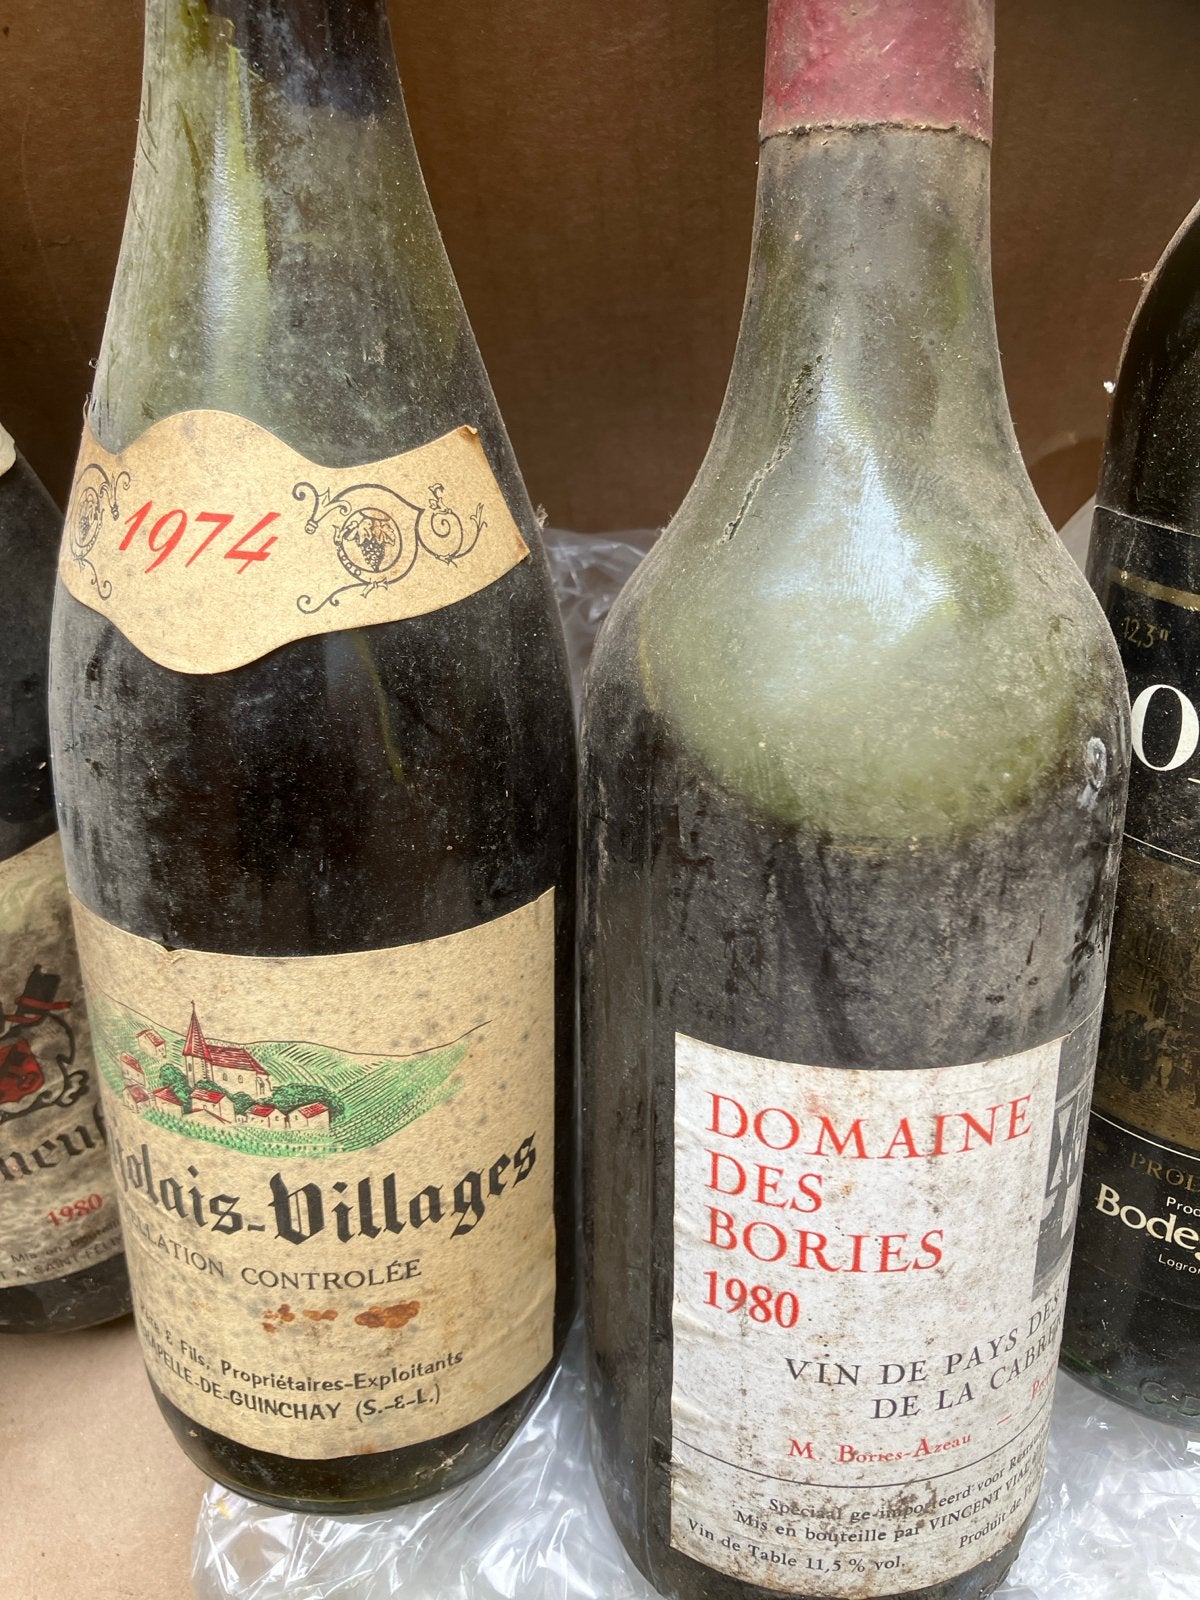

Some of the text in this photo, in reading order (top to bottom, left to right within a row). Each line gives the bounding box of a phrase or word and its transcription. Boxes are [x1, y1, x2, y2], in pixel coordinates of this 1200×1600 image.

[118, 500, 281, 574] 1974
[1131, 684, 1200, 771] O
[704, 1090, 1033, 1159] DOMAINE
[703, 1148, 824, 1213] DES
[47, 1192, 104, 1228] 1980
[702, 1204, 945, 1273] BORIES
[241, 1258, 423, 1291] CONTROLÉE
[702, 1271, 800, 1329] 1980
[180, 1339, 210, 1370] Fils,
[221, 1351, 464, 1392] Propriétaires-Exploitants
[785, 1288, 1060, 1387] VIN DE PAYS DES
[869, 1395, 922, 1420] DE
[934, 1381, 976, 1412] LA
[787, 1433, 973, 1465] M. Bories-Azeau
[974, 1467, 1006, 1493] voor
[688, 1517, 714, 1541] Vin
[721, 1535, 742, 1552] de
[747, 1543, 798, 1568] Table
[805, 1556, 841, 1574] 11,5
[849, 1557, 866, 1573] %
[874, 1555, 906, 1571] vol.
[958, 1511, 1007, 1549] Produit
[735, 1510, 768, 1532] Mis
[775, 1525, 797, 1538] en
[804, 1526, 887, 1543] bouteille
[893, 1525, 922, 1543] par
[929, 1487, 1002, 1531] VINCENT
